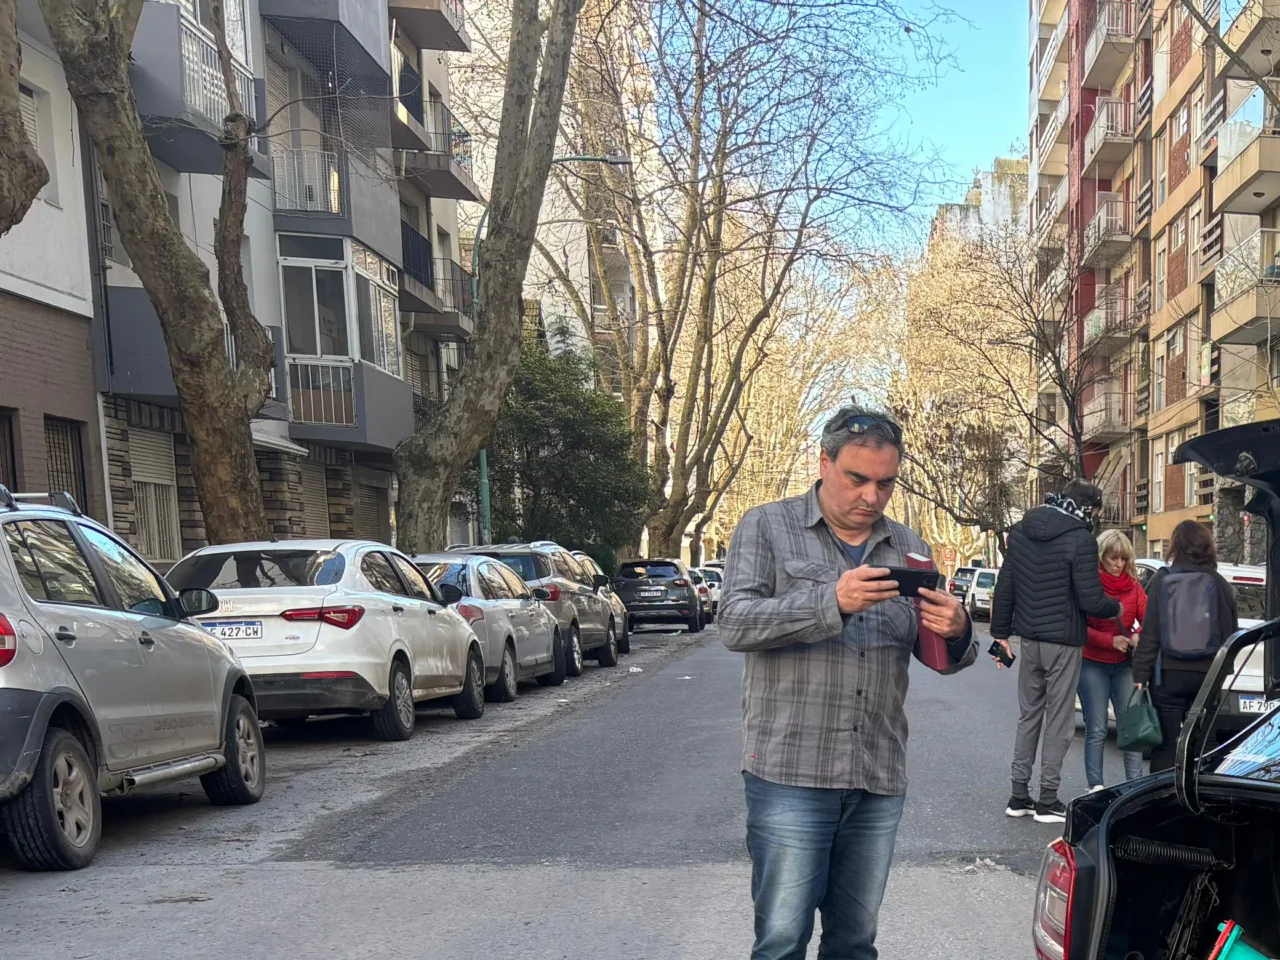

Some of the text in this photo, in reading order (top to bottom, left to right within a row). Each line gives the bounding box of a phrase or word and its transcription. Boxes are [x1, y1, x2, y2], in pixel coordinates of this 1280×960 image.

[220, 627, 241, 638] 427
[245, 626, 259, 637] CW
[1243, 700, 1254, 711] AF
